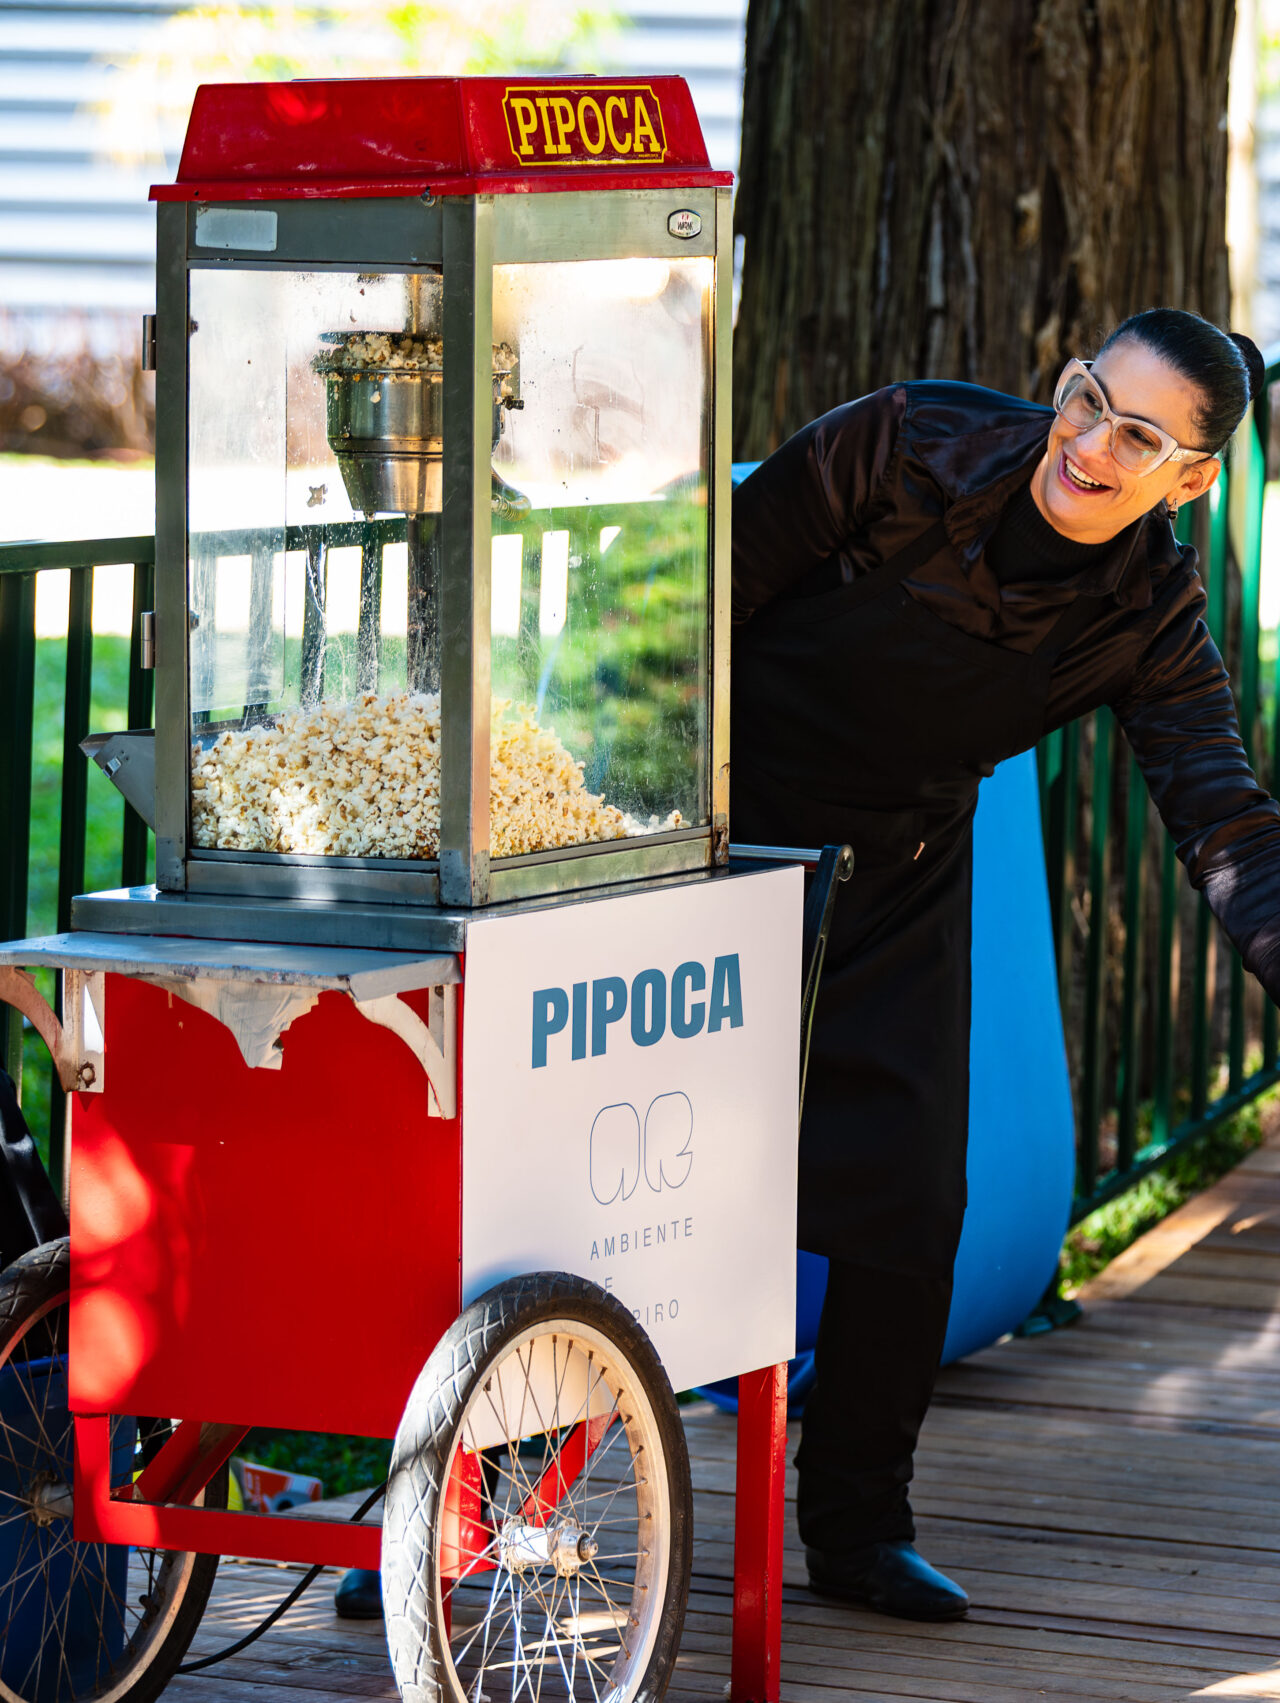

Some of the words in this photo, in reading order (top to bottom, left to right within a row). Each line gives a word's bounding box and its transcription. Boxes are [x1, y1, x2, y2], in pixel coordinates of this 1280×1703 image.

[510, 95, 661, 156] PIPOCA
[531, 952, 744, 1069] PIPOCA
[590, 1217, 693, 1261] AMBIENTE
[632, 1299, 679, 1326] PIRO
